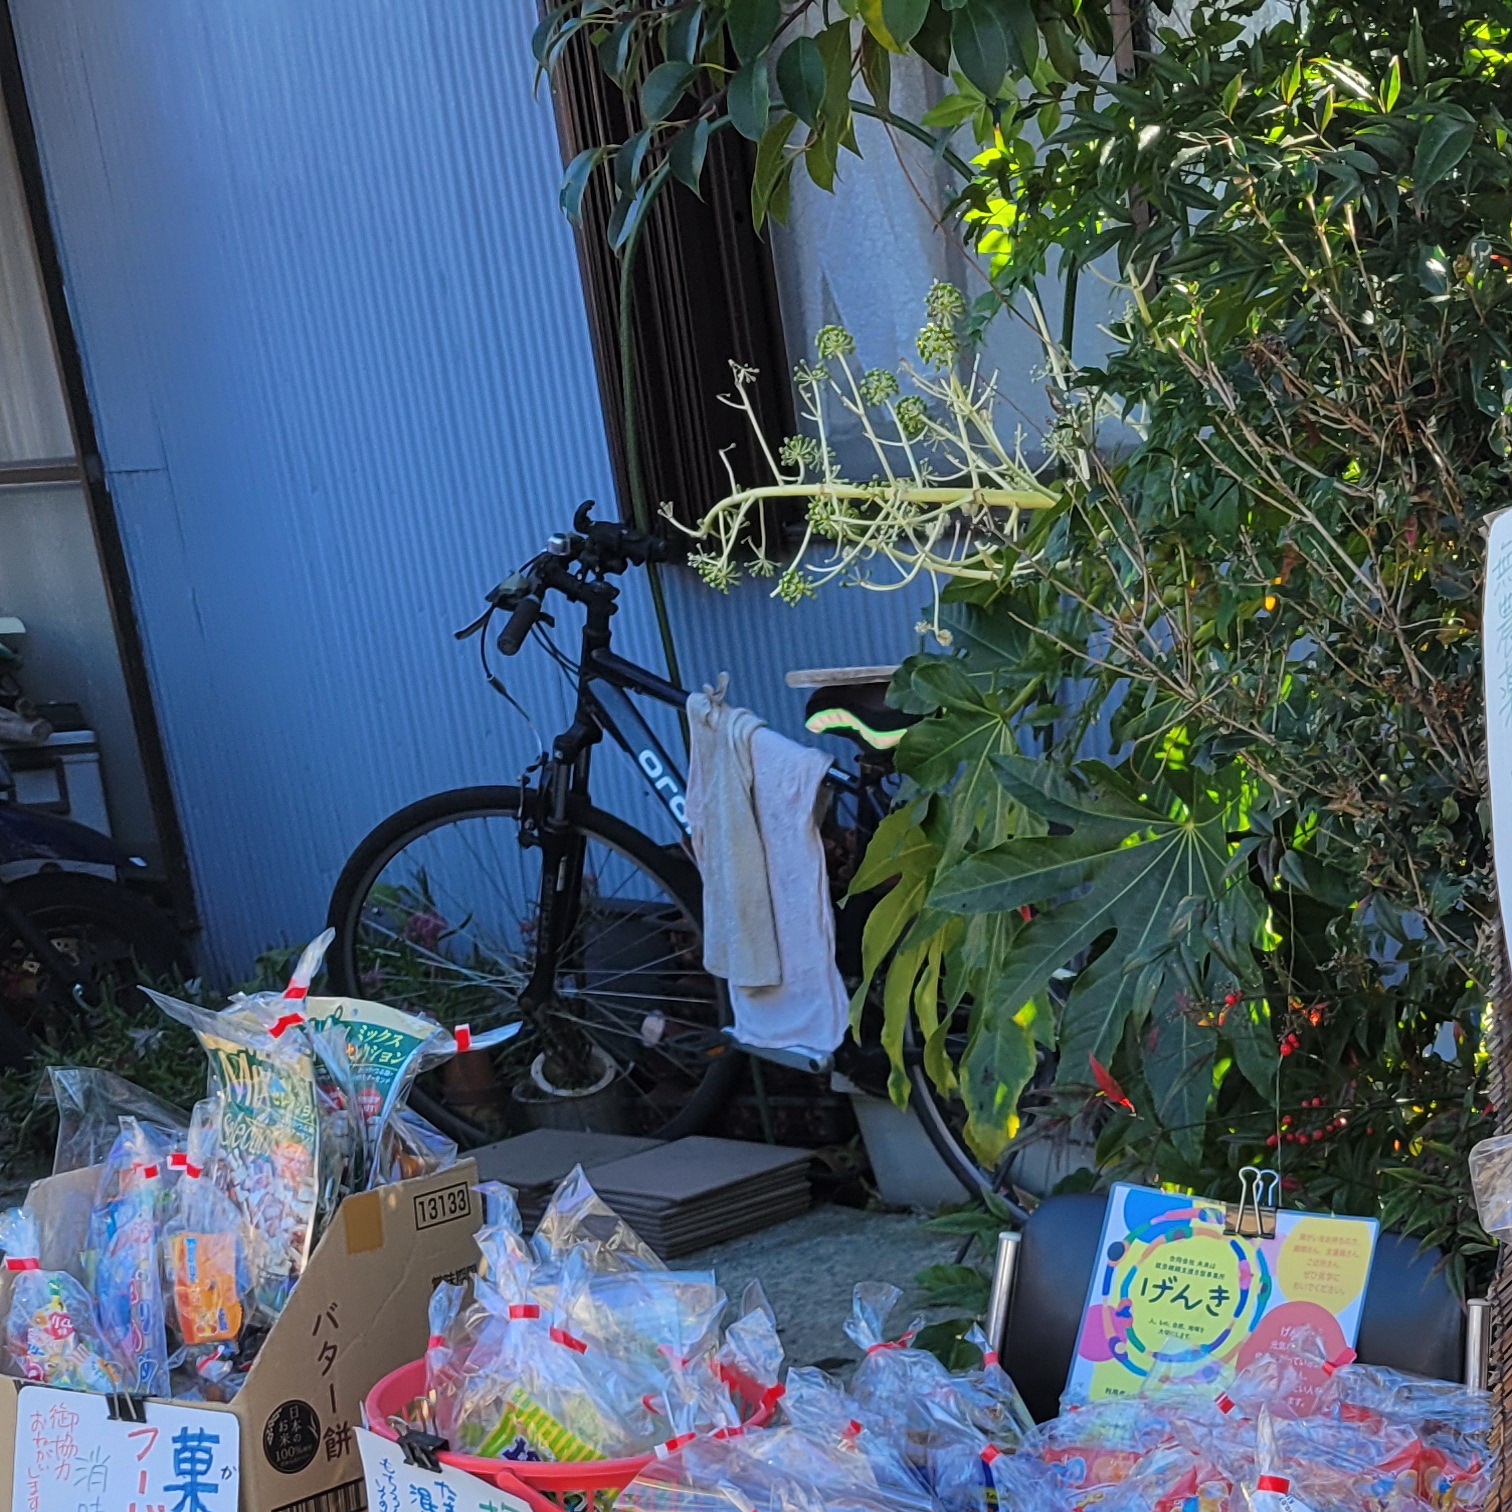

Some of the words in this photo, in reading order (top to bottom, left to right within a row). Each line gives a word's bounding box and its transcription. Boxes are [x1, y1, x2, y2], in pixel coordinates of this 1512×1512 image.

[418, 1188, 468, 1222] 13133
[1139, 1275, 1231, 1318] げんき
[311, 1299, 352, 1464] バター餅
[49, 1401, 80, 1482] 御協力
